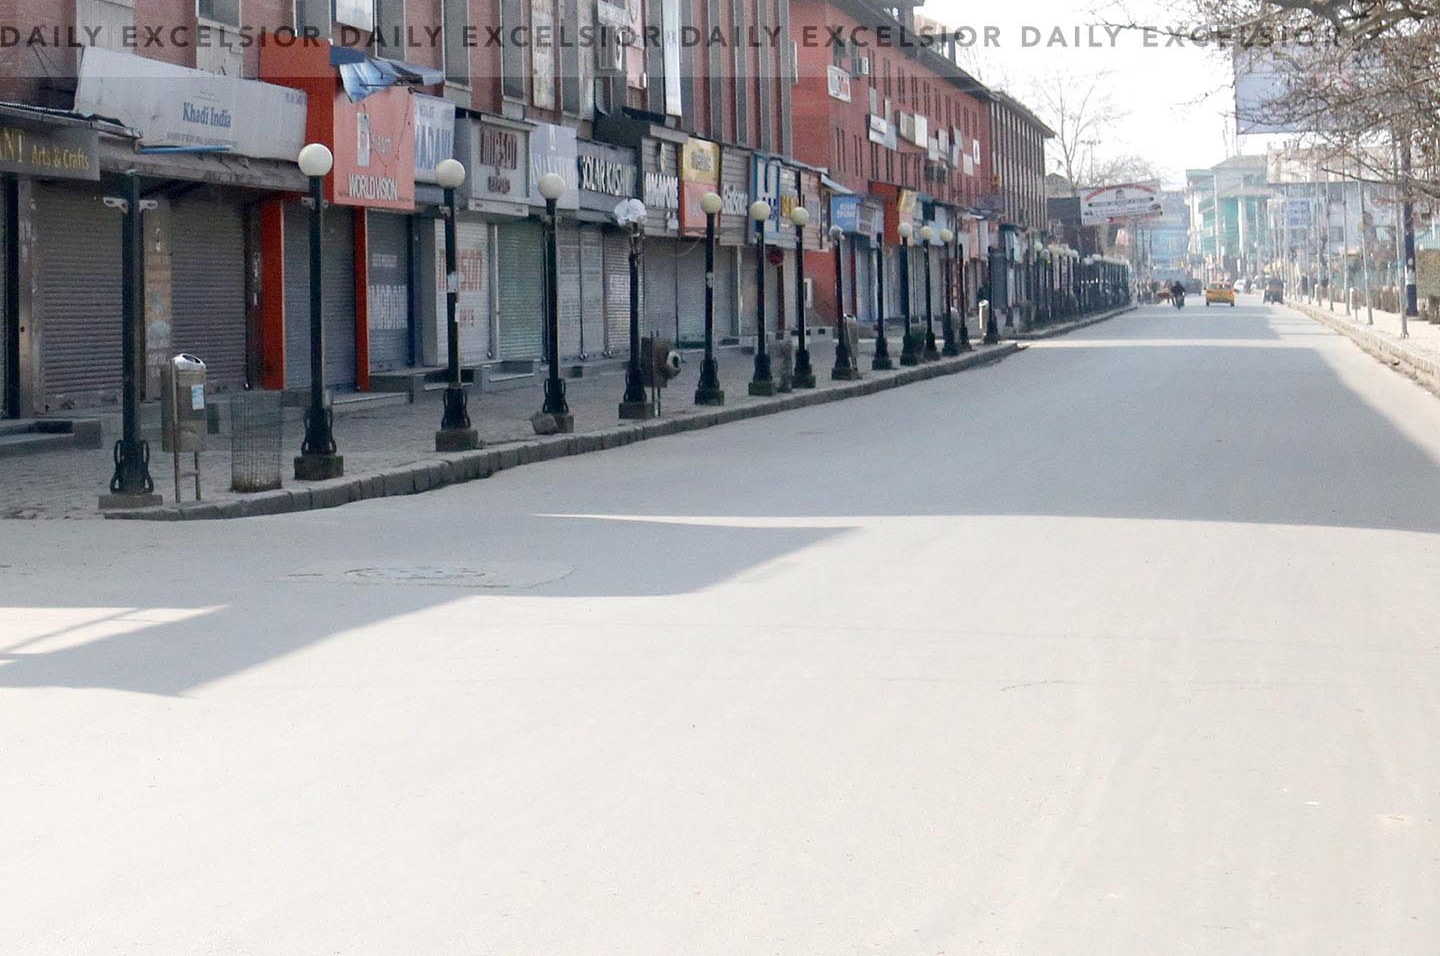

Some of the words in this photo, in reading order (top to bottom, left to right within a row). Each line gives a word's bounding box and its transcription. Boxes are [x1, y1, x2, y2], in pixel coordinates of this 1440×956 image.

[183, 102, 210, 125] Khadi
[211, 106, 231, 129] India
[31, 145, 50, 166] Arts
[52, 149, 62, 168] &
[63, 148, 90, 170] Crafts
[349, 173, 376, 200] WORLD
[376, 176, 398, 201] VISION
